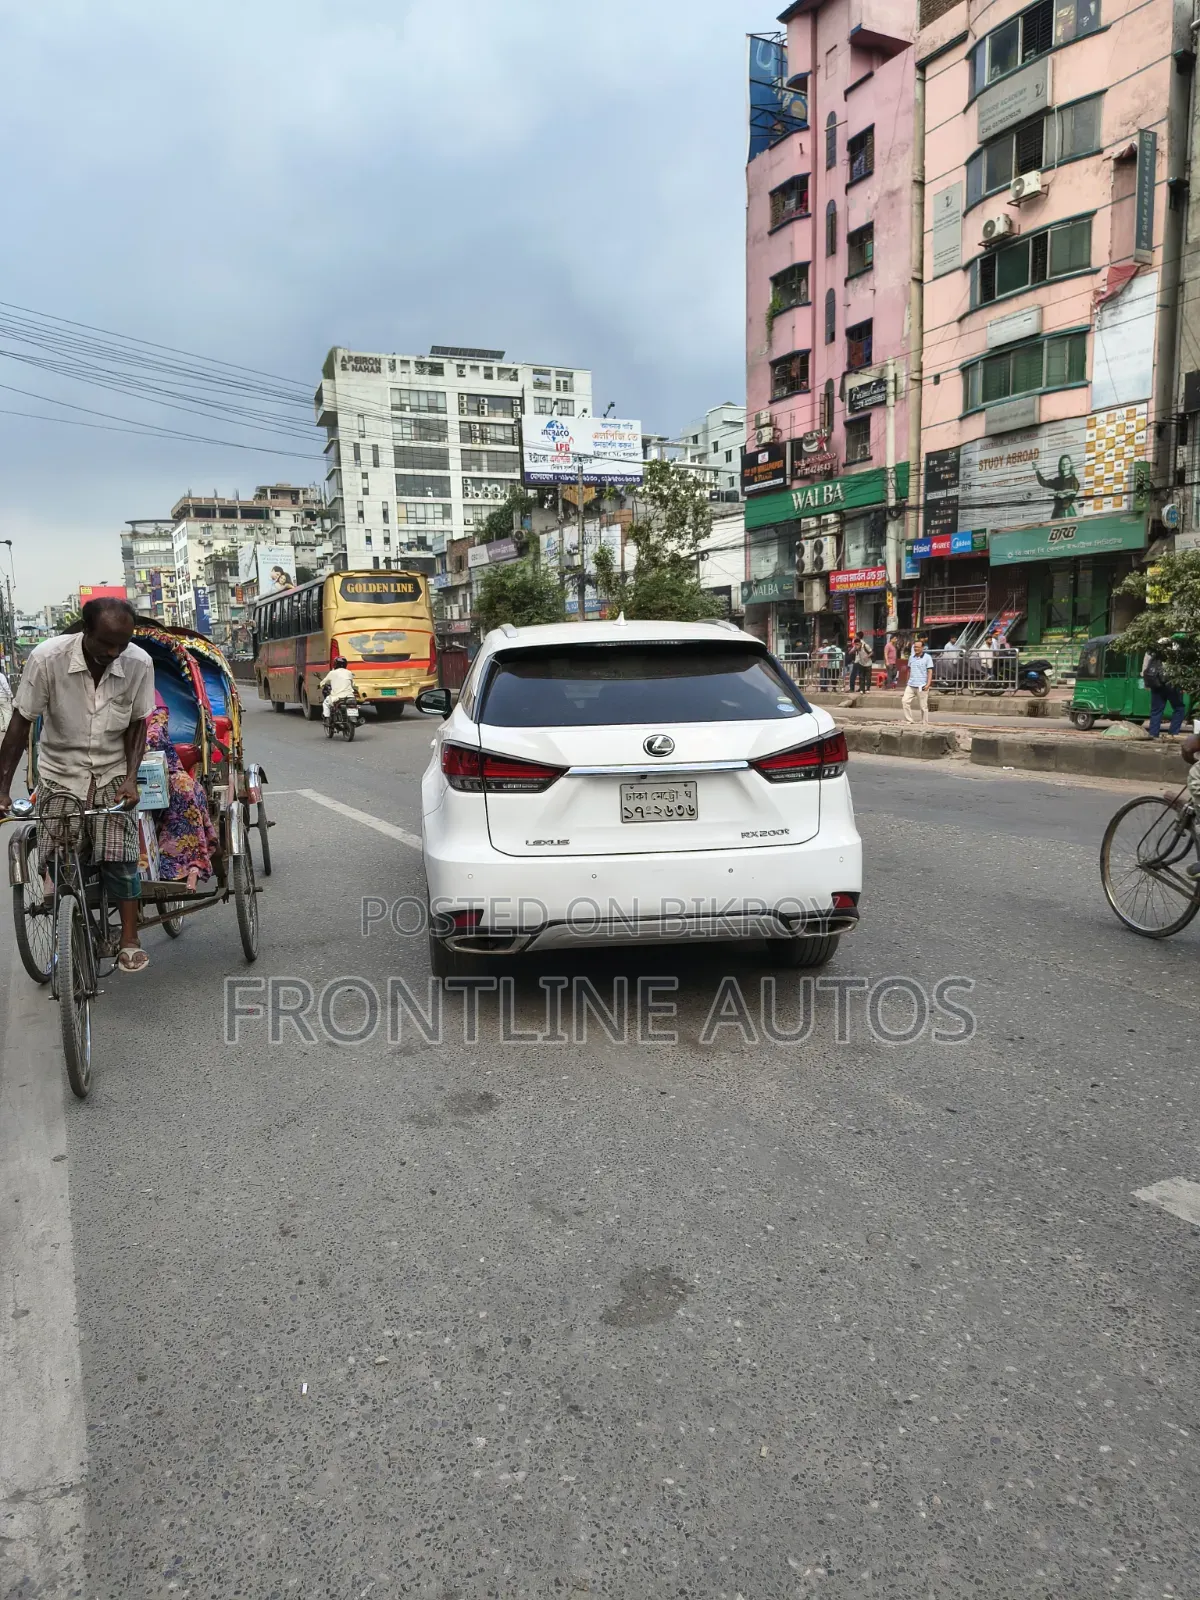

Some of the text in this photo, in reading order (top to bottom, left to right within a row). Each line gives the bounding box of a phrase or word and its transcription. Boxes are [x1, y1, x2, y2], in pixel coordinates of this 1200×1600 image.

[340, 355, 381, 366] APEIRON
[351, 364, 381, 374] NAHAR
[556, 443, 570, 452] LPG
[979, 448, 1040, 471] STUDY ABROAD
[1049, 526, 1077, 541] BRB
[913, 544, 931, 553] Haier
[346, 583, 415, 593] GOLDEN LINE
[752, 583, 779, 597] WALBA
[626, 791, 647, 801] ঢাকা
[623, 804, 696, 819] ১৭-২৬৩৬
